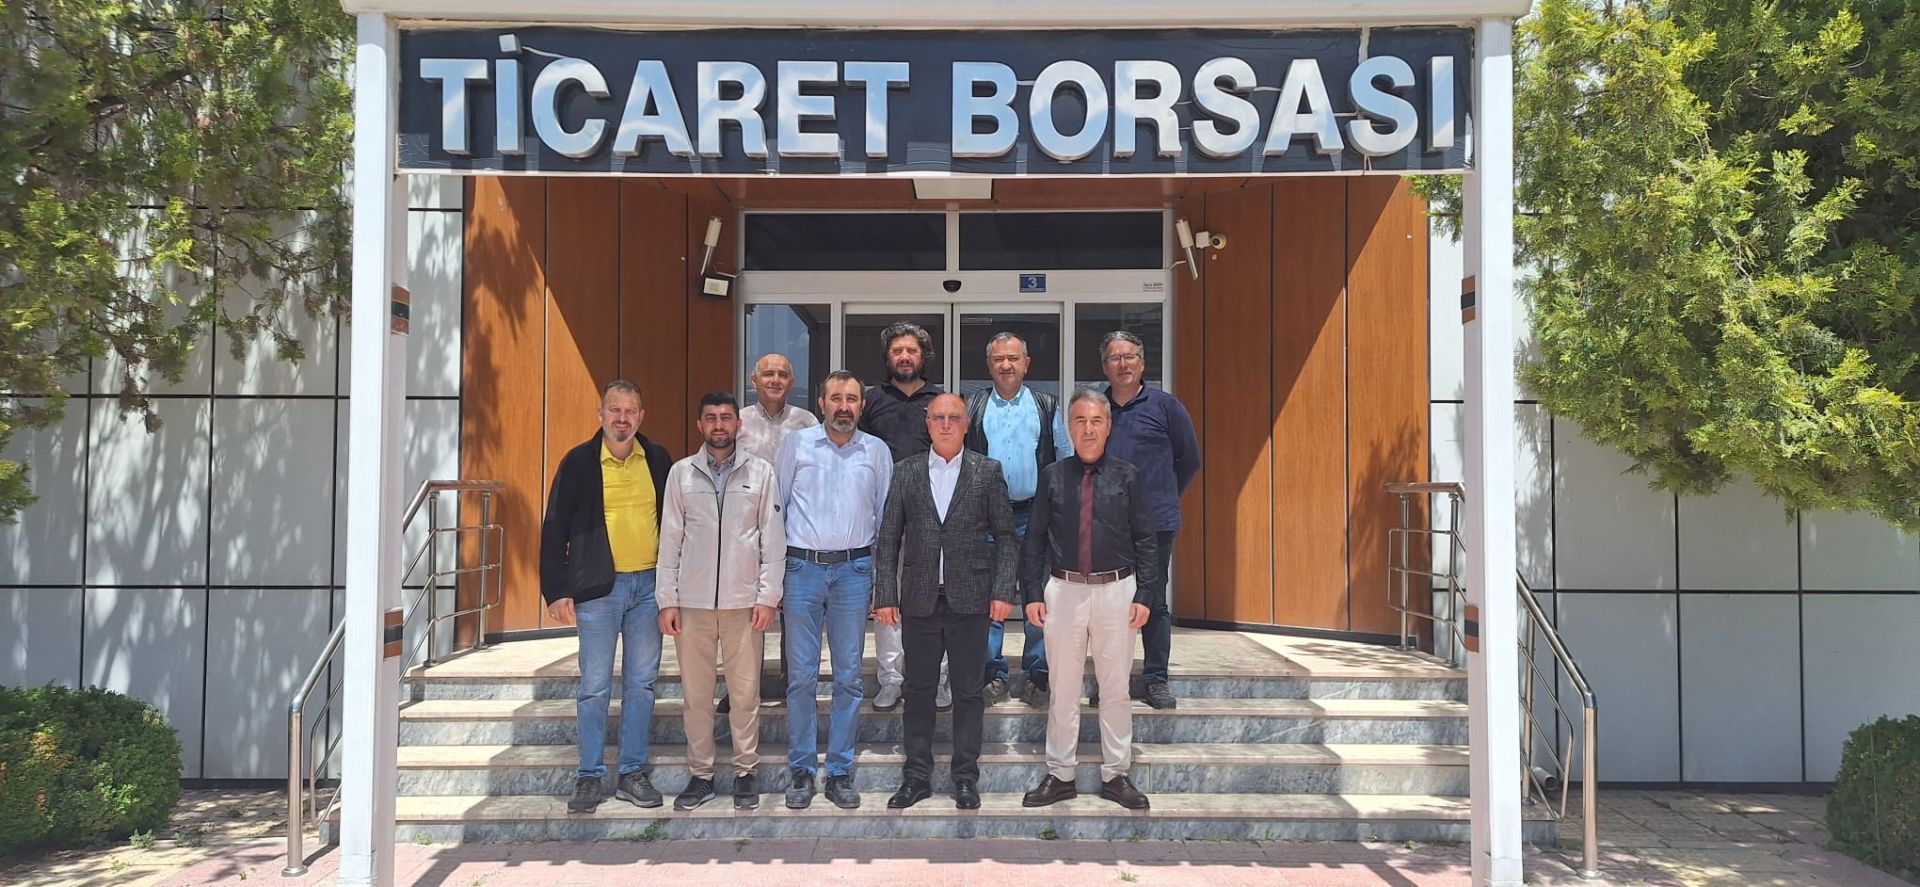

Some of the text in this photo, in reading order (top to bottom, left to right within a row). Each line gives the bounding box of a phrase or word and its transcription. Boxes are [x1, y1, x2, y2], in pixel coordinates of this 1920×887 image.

[419, 34, 1455, 160] TİCARET BORSASI
[1028, 277, 1038, 289] 3
